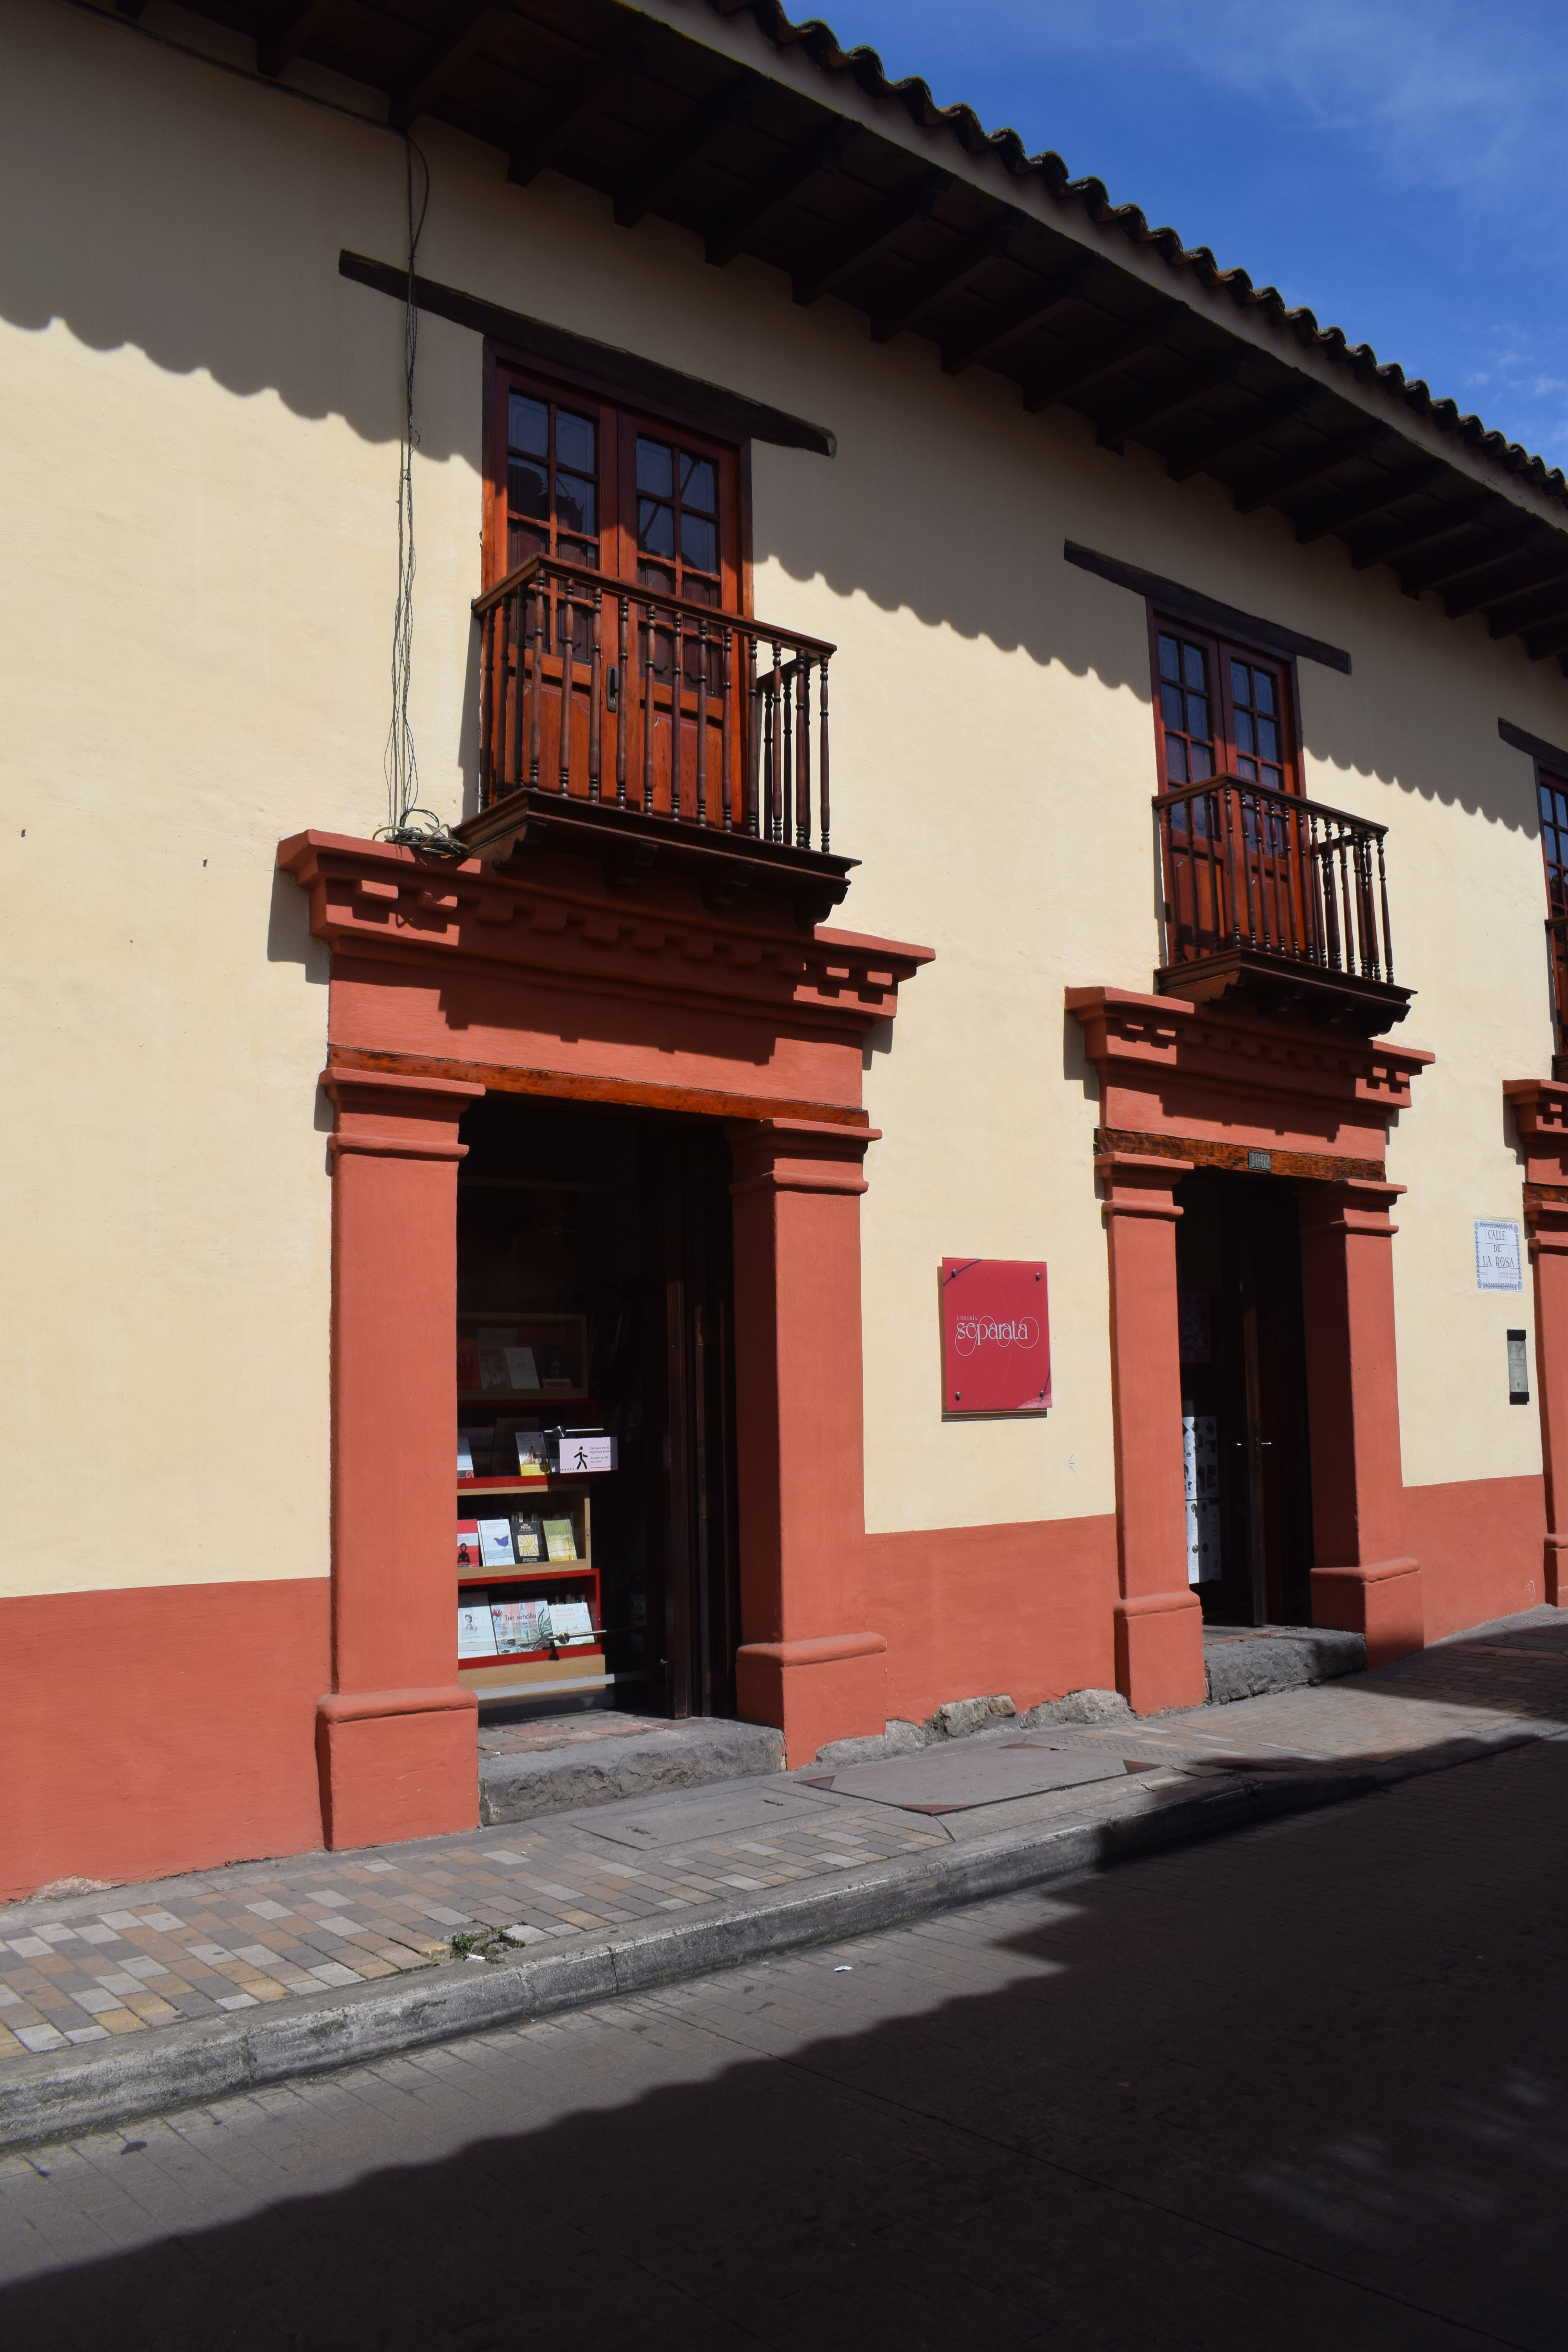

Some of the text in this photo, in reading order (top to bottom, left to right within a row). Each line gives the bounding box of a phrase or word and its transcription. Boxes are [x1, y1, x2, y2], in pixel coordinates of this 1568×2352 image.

[1250, 1152, 1270, 1169] 10-02
[1488, 1229, 1506, 1241] CALLE
[1483, 1255, 1515, 1268] LA ROSA
[956, 1319, 1029, 1347] separata
[516, 1612, 536, 1621] sencillo
